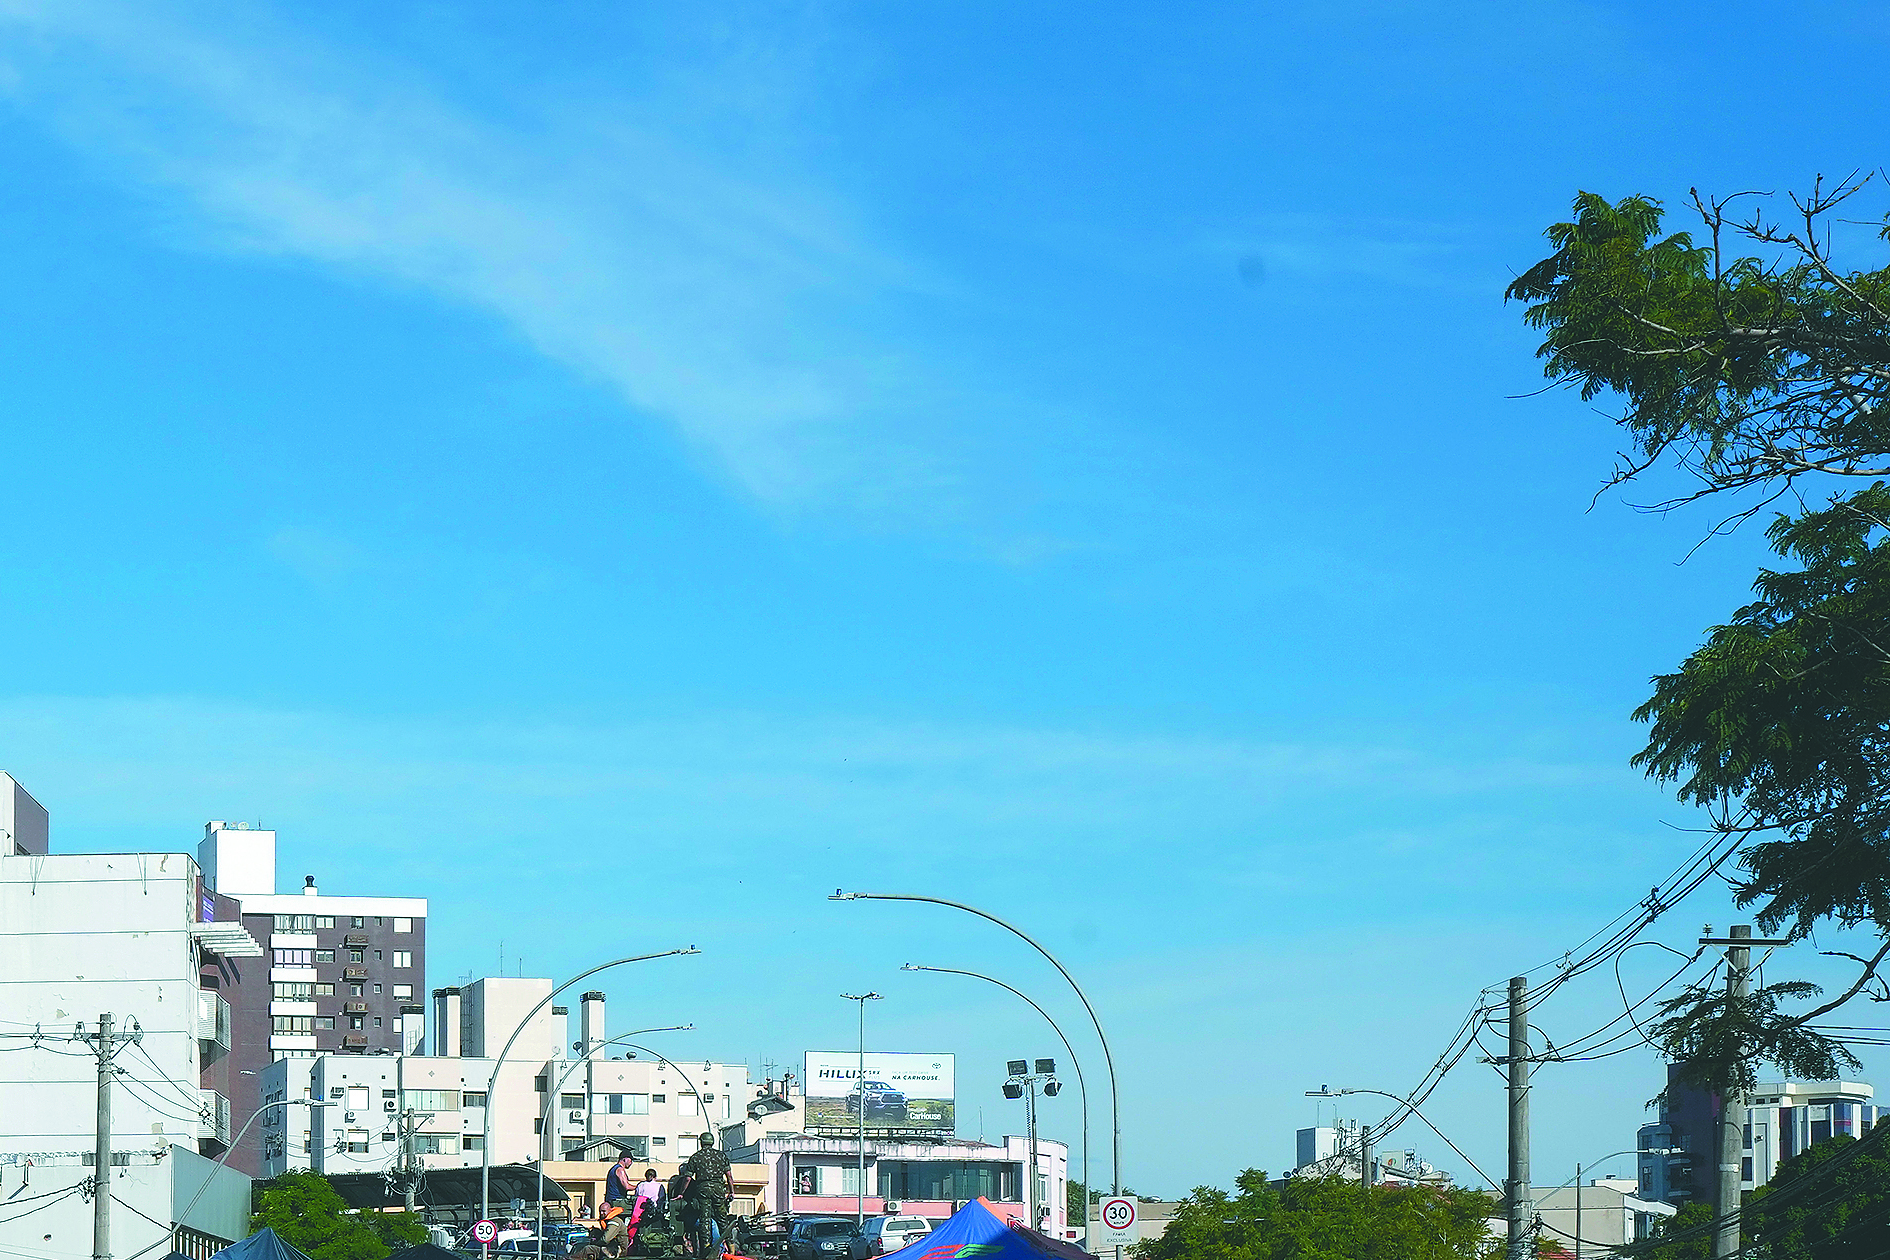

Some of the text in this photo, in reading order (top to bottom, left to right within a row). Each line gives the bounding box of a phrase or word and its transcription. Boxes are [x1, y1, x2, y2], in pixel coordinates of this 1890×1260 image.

[819, 1069, 868, 1079] HILUX
[1109, 1206, 1128, 1220] 30
[478, 1225, 493, 1236] 50
